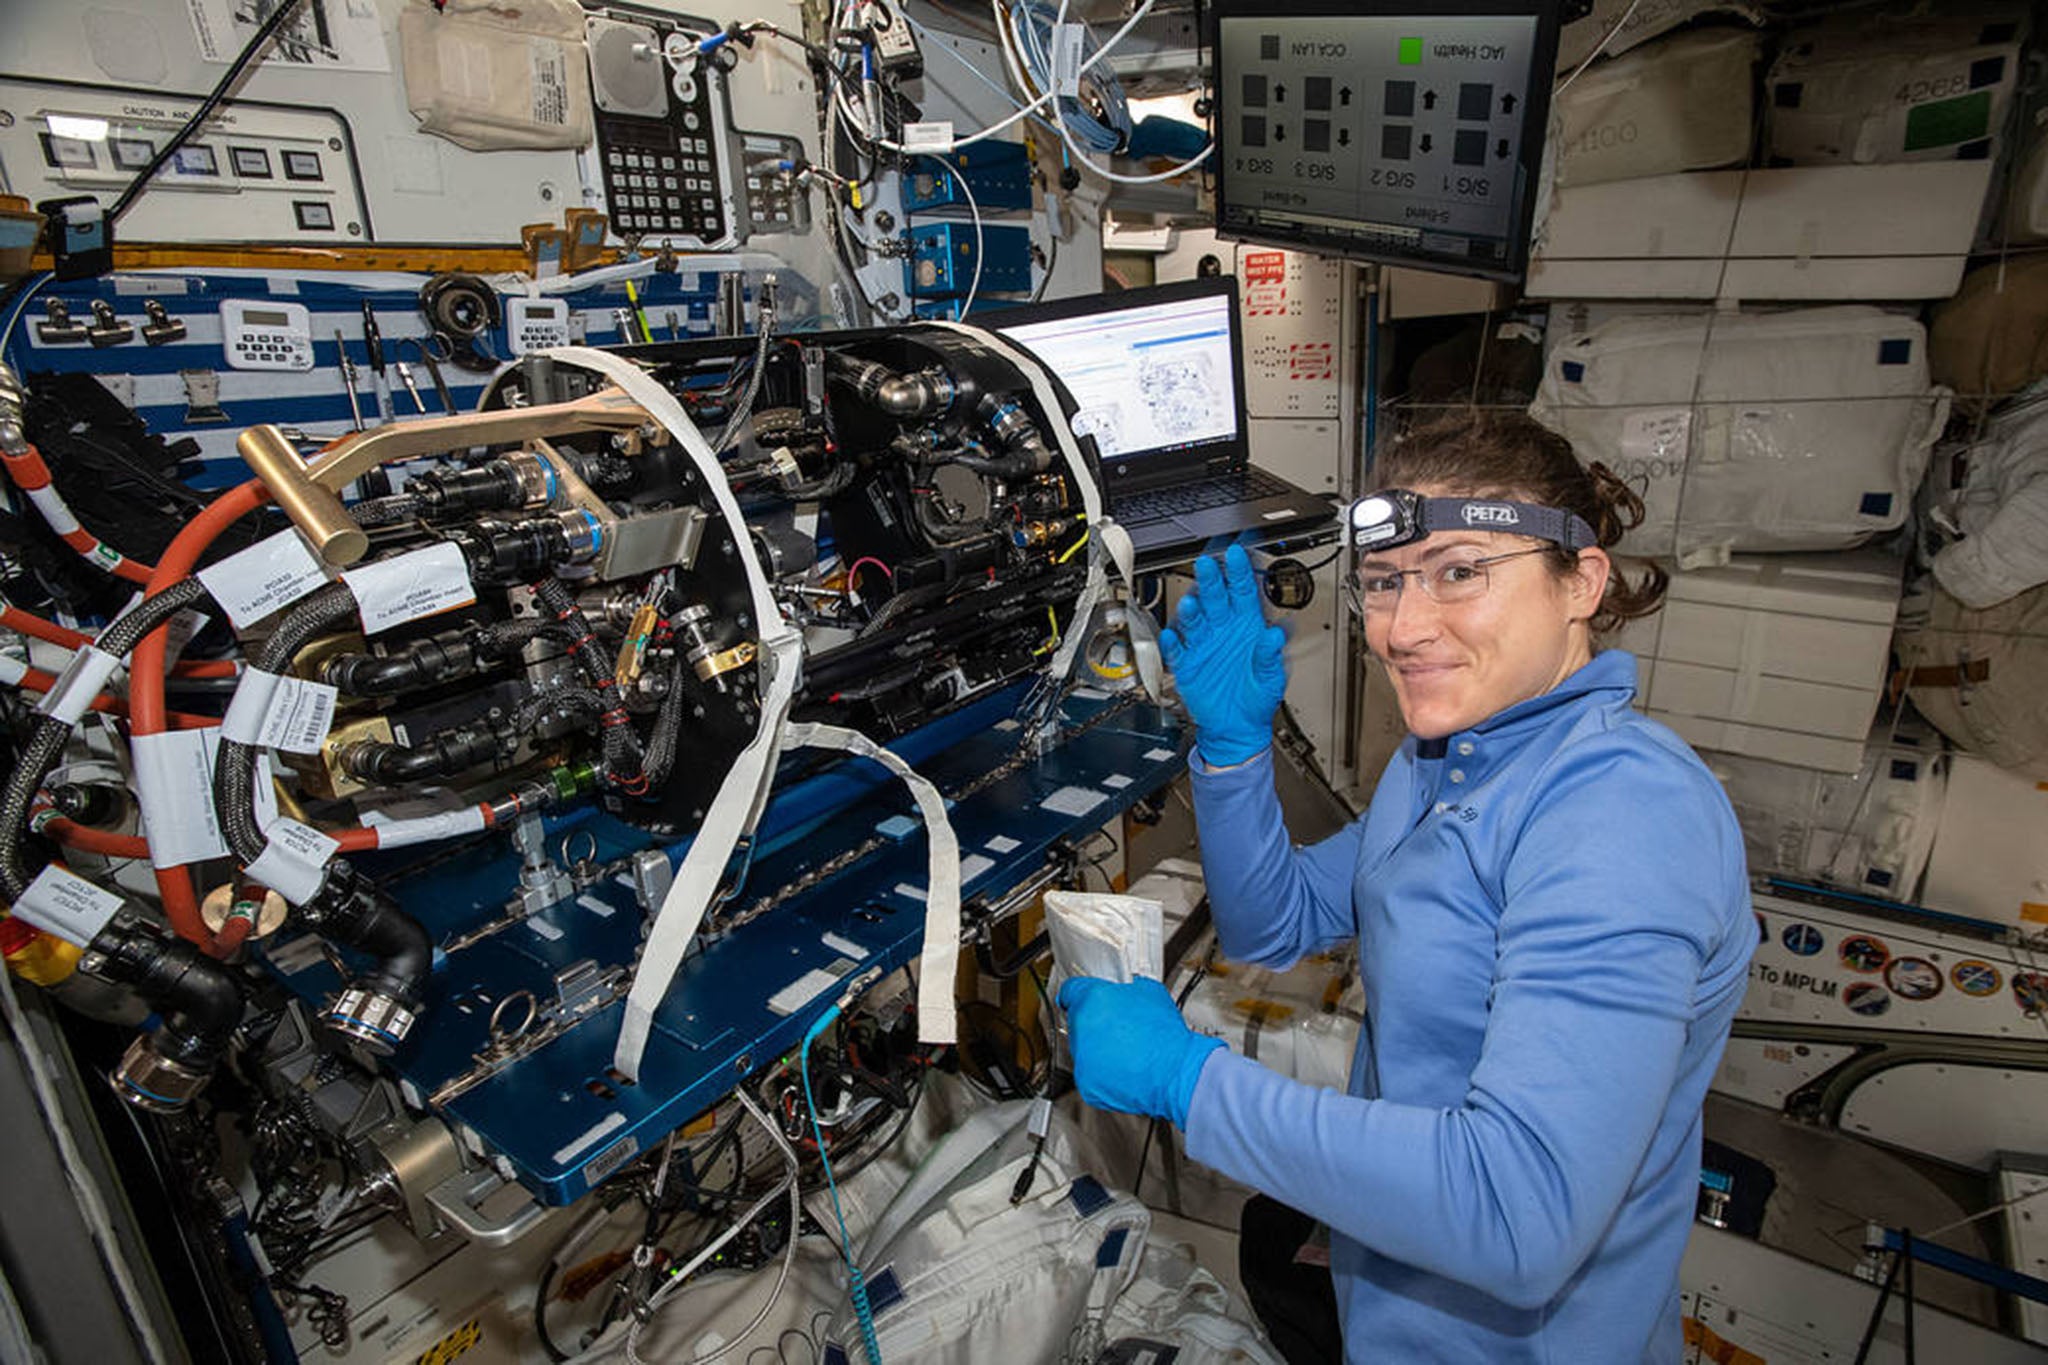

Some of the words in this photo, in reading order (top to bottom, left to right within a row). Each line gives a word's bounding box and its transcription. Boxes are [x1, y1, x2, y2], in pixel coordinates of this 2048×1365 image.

[1292, 42, 1315, 56] LAN
[1434, 44, 1475, 60] Health
[123, 106, 165, 118] CAUTION
[172, 111, 191, 119] AND
[1235, 158, 1243, 172] 4
[1249, 159, 1273, 174] S/G
[1294, 162, 1302, 177] 3
[1308, 163, 1336, 181] S/G
[1370, 169, 1383, 186] 2
[1386, 170, 1416, 189] S/G
[1443, 176, 1450, 192] 1
[1456, 176, 1490, 197] S/G
[1464, 504, 1518, 523] PETZL
[240, 603, 251, 614] To
[272, 575, 306, 596] Chamber
[409, 593, 442, 607] Chamber
[280, 826, 313, 847] Chamber
[48, 880, 88, 905] Chamber
[1759, 964, 1778, 983] To
[1783, 970, 1837, 997] MPLM
